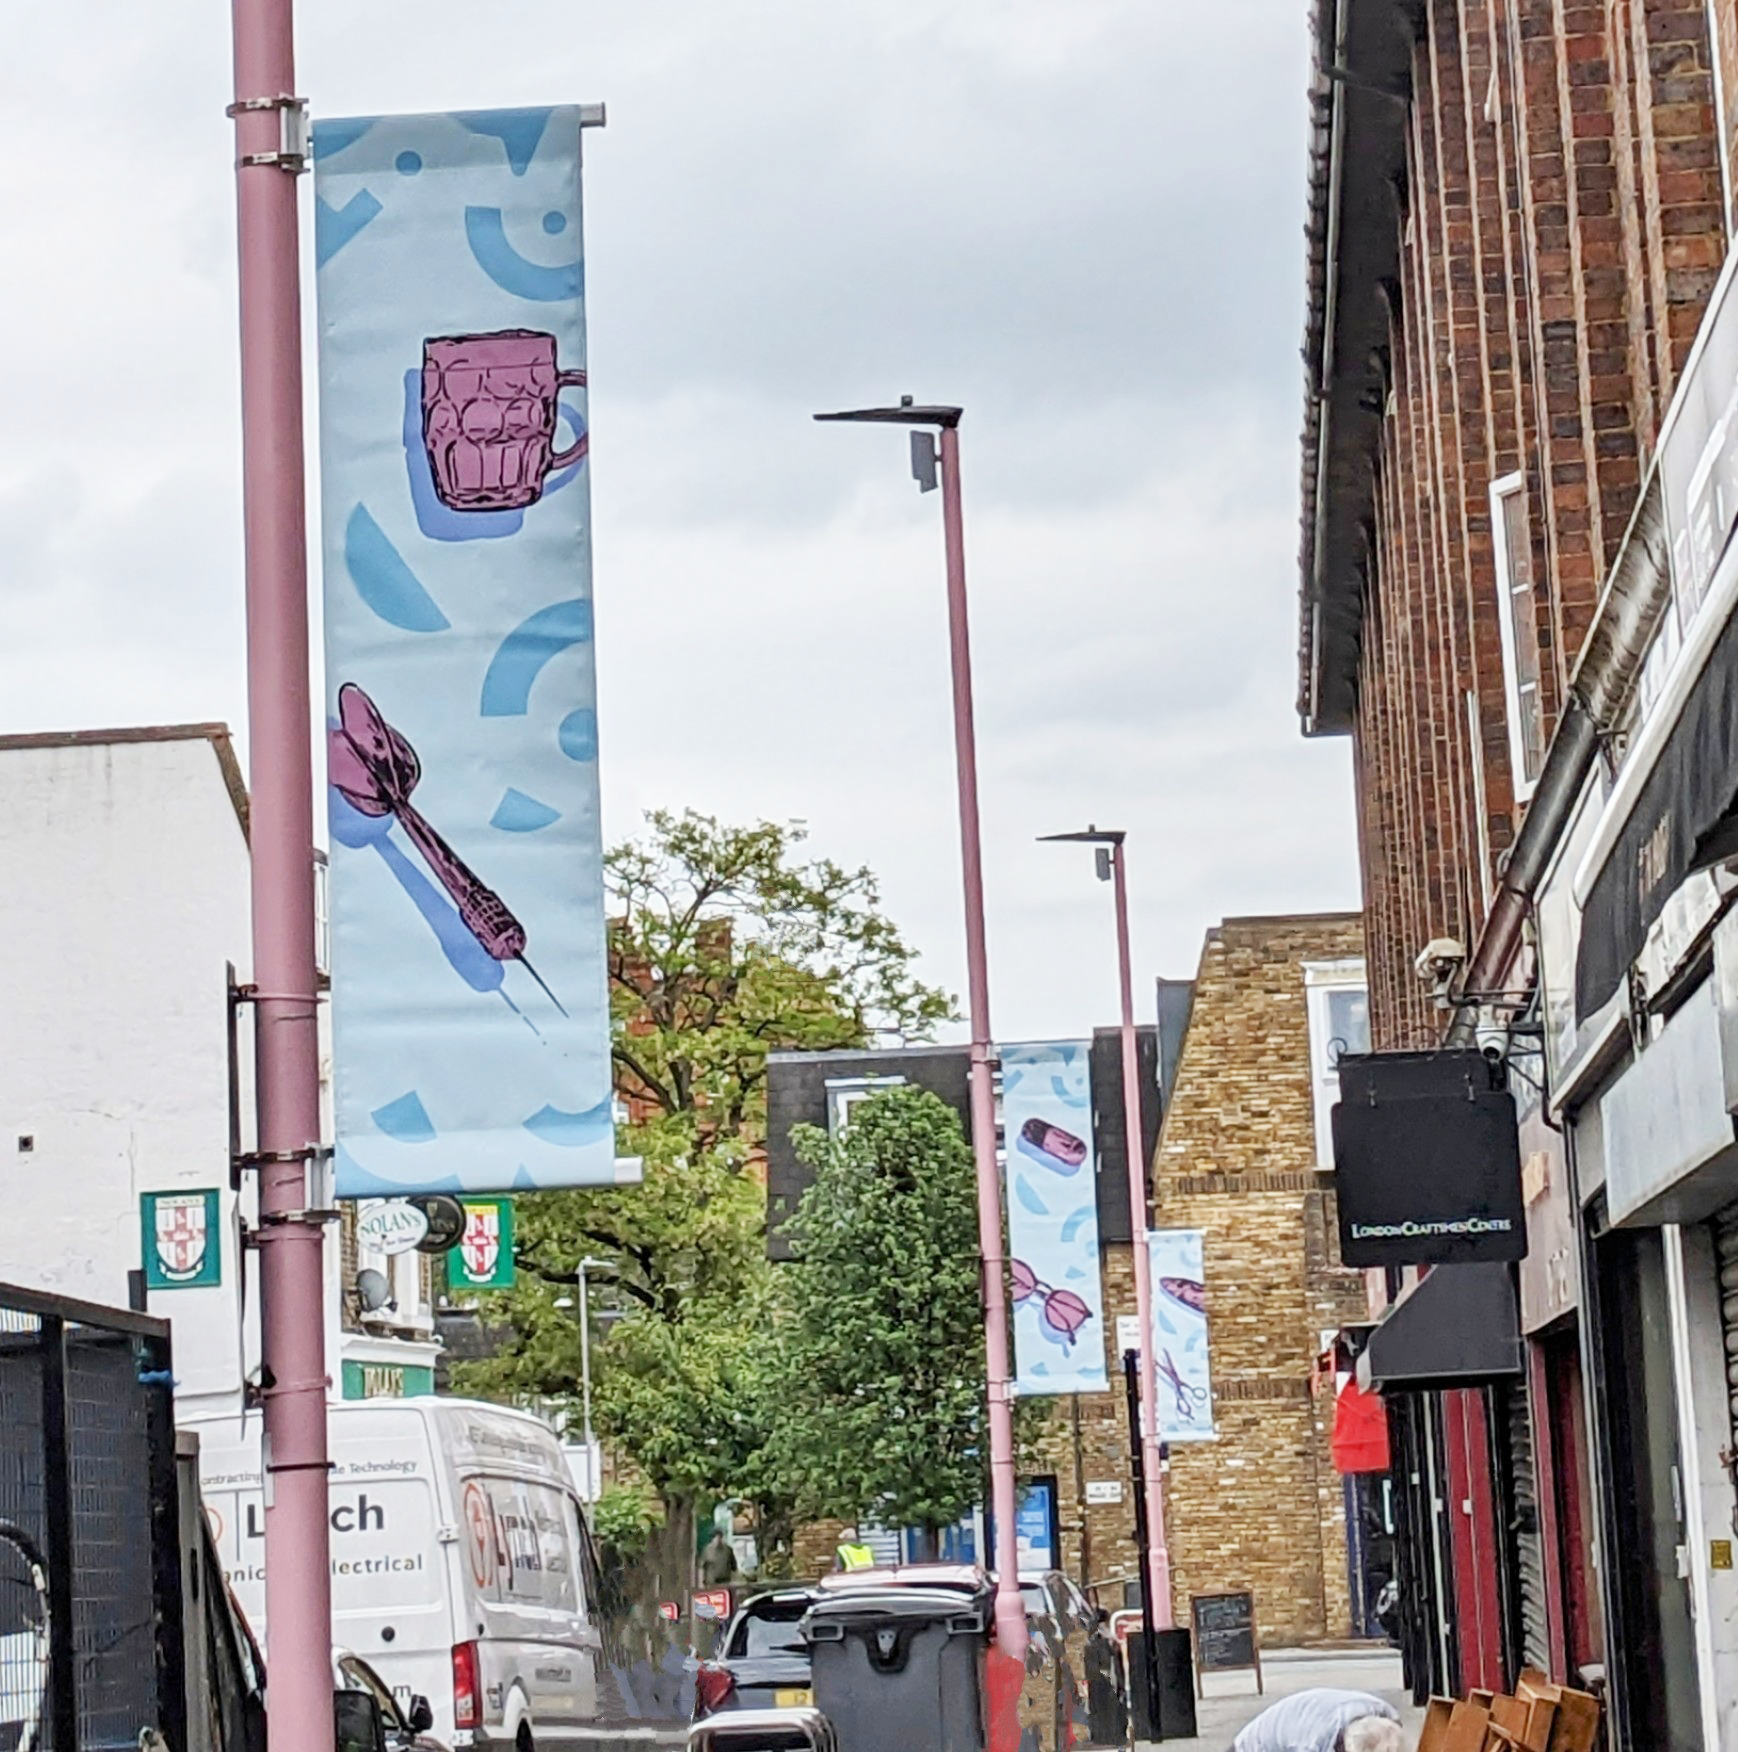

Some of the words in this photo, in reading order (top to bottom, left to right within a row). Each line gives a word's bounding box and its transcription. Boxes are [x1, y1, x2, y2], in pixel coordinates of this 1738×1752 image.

[201, 1470, 261, 1486] ontracting
[349, 1460, 418, 1475] Technology
[247, 1494, 385, 1538] Lch
[332, 1554, 423, 1576] lectrical
